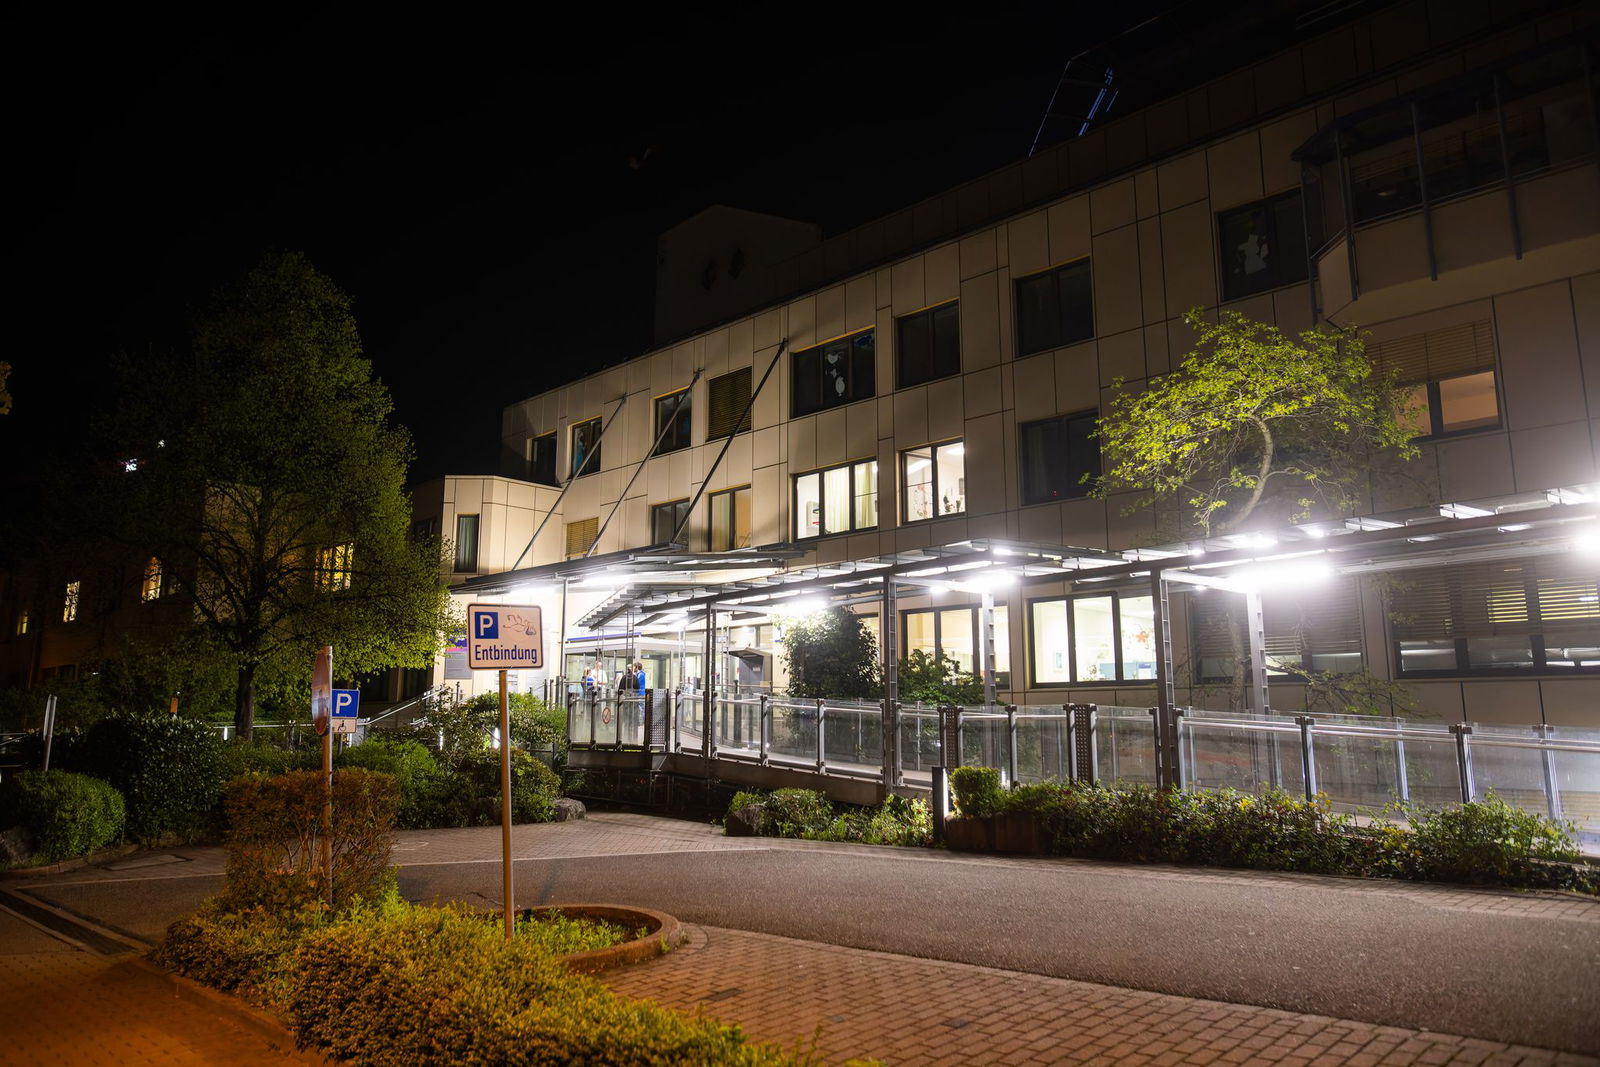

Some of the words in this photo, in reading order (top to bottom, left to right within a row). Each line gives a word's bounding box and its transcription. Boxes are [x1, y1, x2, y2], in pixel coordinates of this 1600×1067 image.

[480, 614, 494, 636] P
[475, 644, 537, 664] Entbindung
[336, 693, 352, 714] P
